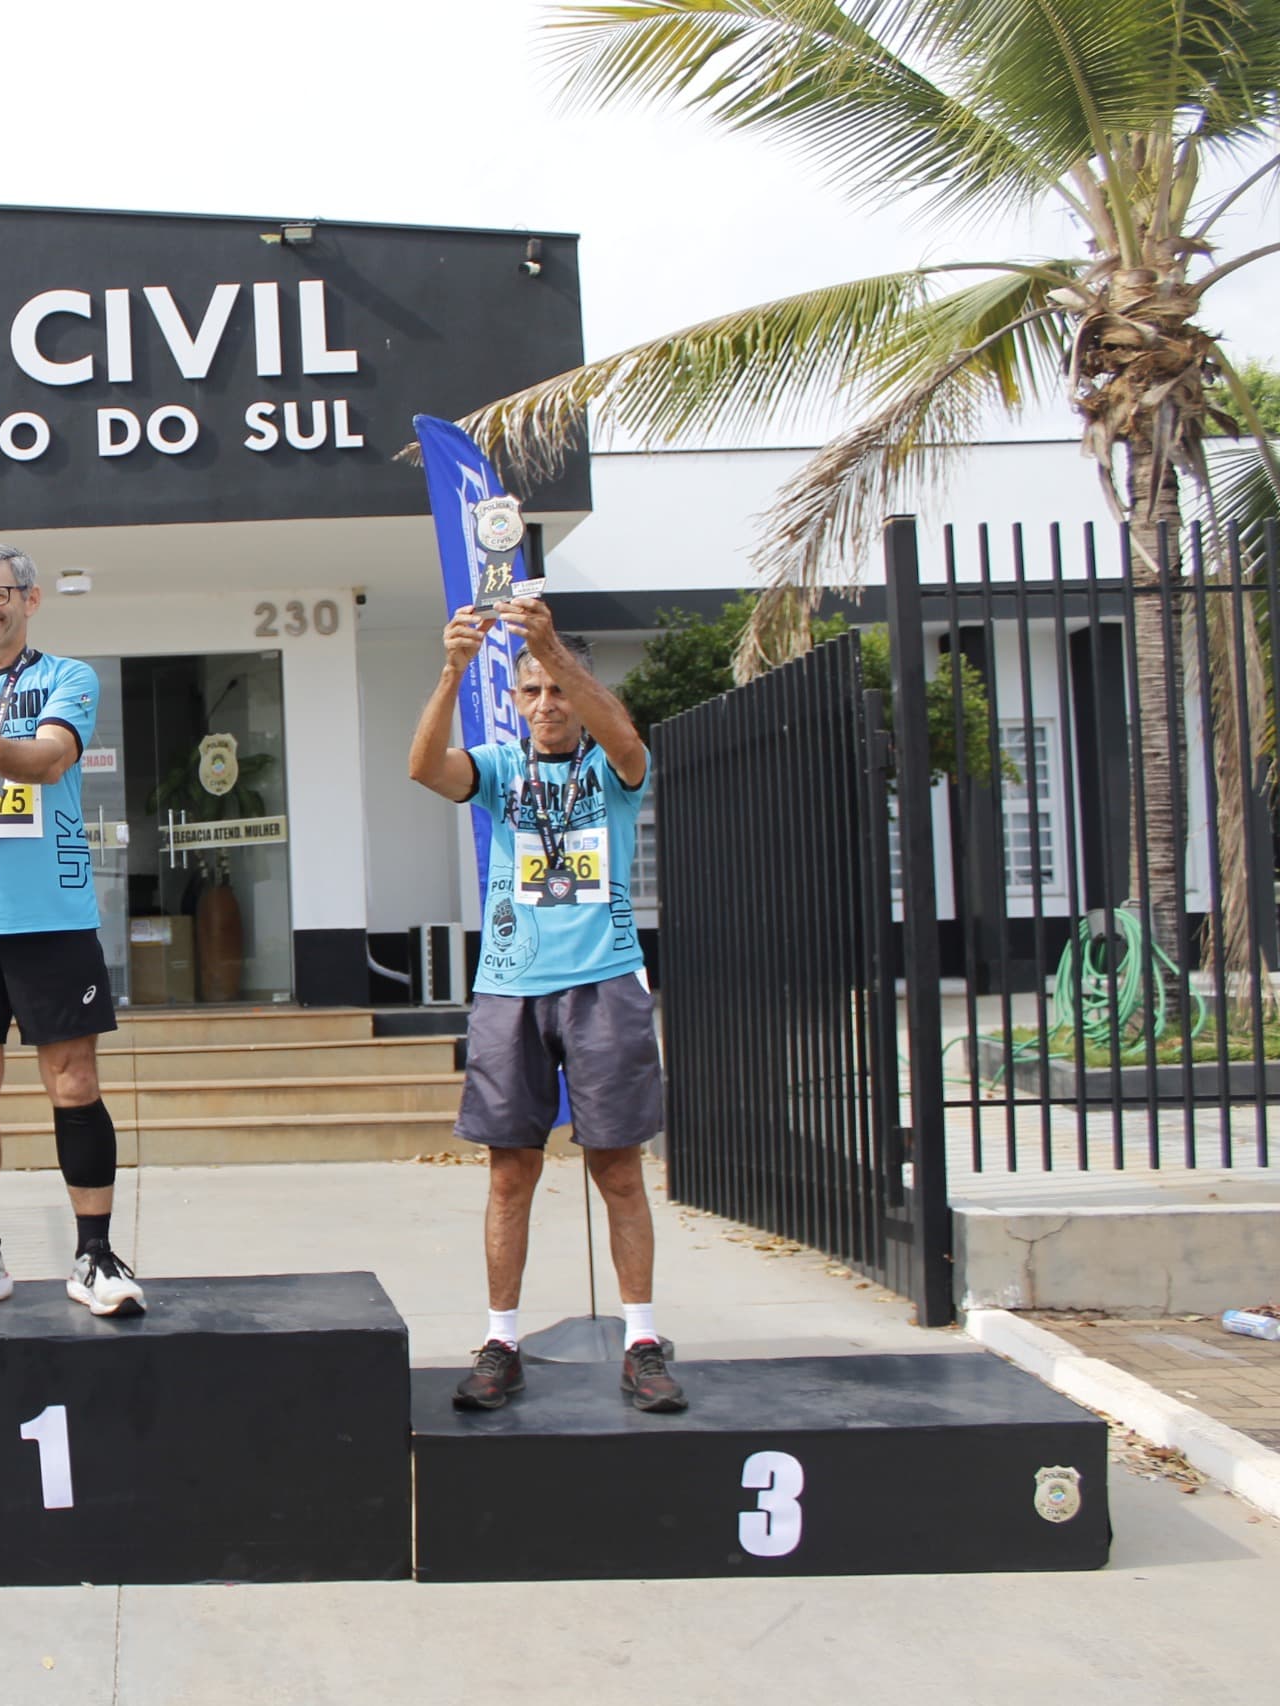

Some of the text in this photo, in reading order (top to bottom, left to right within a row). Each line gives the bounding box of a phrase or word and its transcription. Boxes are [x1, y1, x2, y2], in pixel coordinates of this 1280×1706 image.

[10, 280, 358, 386] CIVIL
[97, 407, 199, 456] DO
[244, 400, 364, 451] SUL
[255, 600, 339, 637] 230
[245, 821, 281, 837] MULHER
[484, 954, 517, 968] CIVIL
[20, 1406, 74, 1509] 1
[738, 1450, 805, 1558] 3
